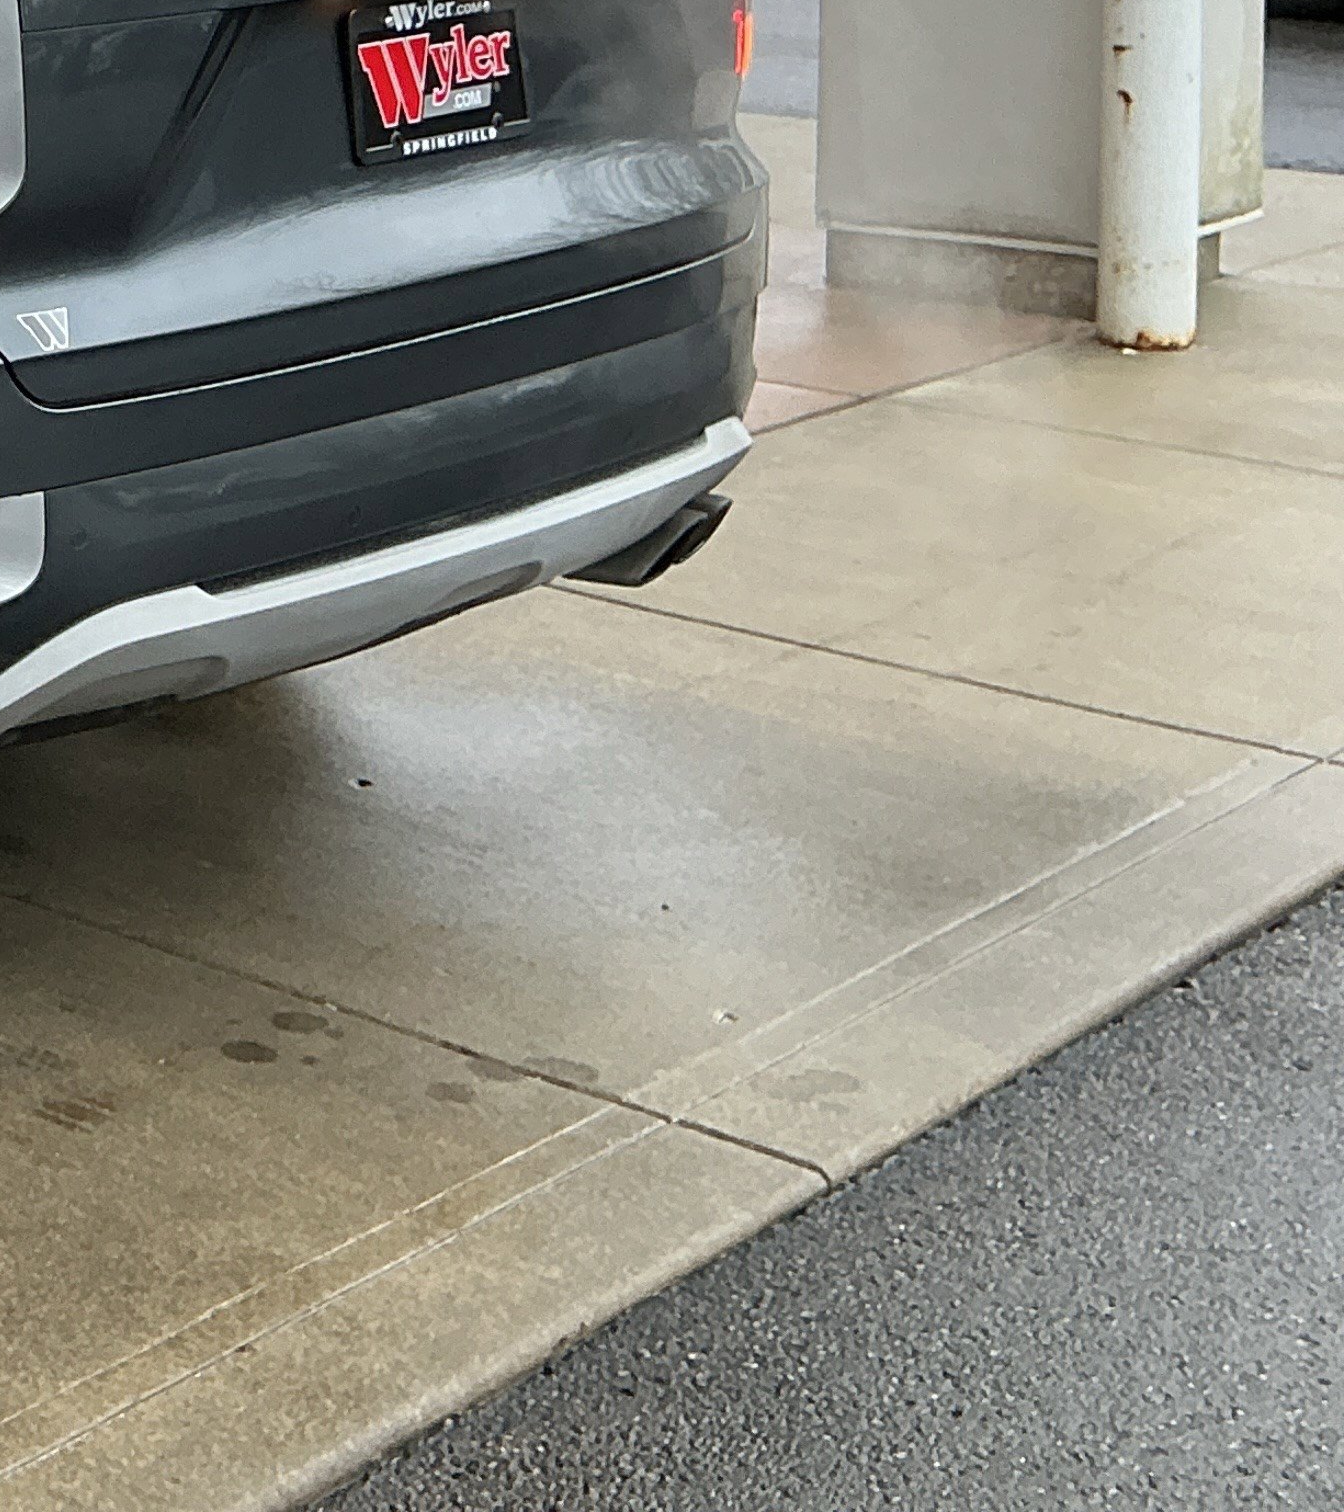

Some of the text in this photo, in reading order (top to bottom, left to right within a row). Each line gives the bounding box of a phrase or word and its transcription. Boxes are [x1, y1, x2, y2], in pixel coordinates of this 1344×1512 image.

[358, 23, 510, 128] Wyler
[403, 127, 498, 156] SPRINGFIELD
[16, 306, 69, 351] W
